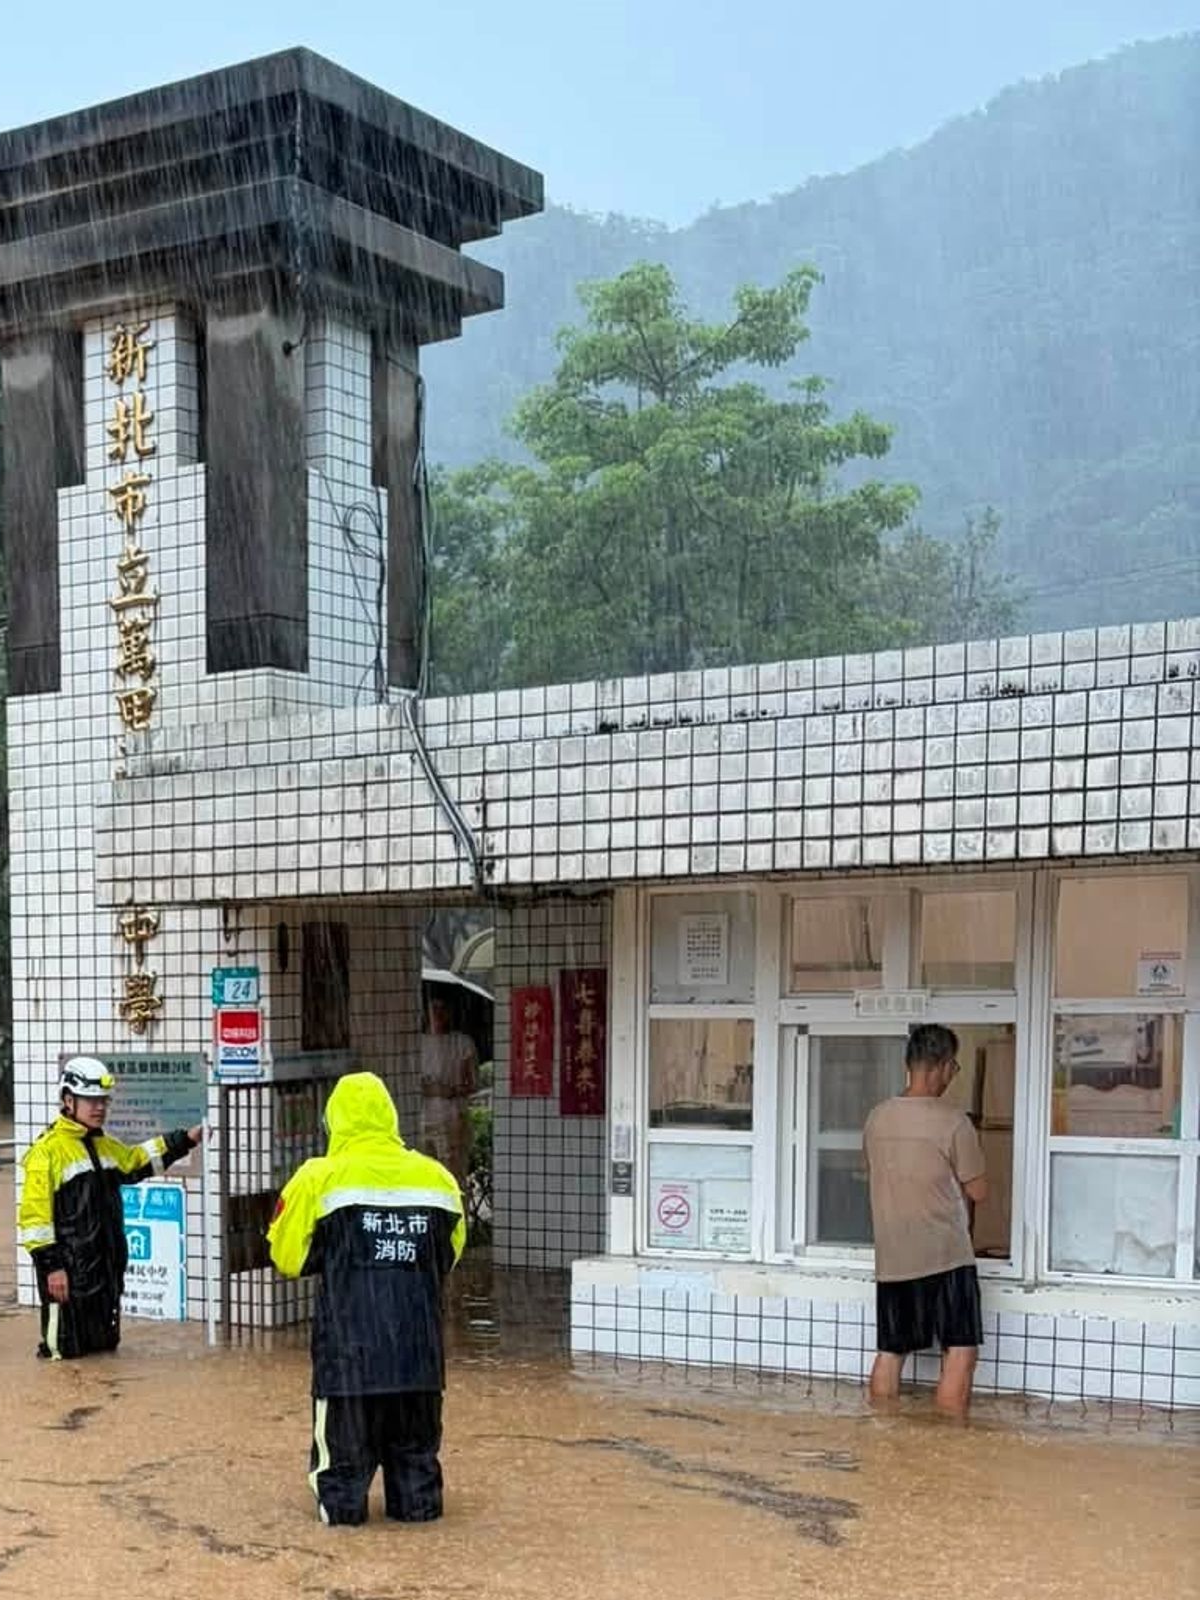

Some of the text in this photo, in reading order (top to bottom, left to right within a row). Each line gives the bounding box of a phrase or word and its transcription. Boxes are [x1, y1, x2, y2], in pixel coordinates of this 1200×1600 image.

[106, 322, 158, 780] 新北市立萬里
[231, 980, 251, 999] 24
[222, 1046, 258, 1058] SECOM
[362, 1212, 429, 1236] 新北市
[374, 1238, 417, 1261] 消防
